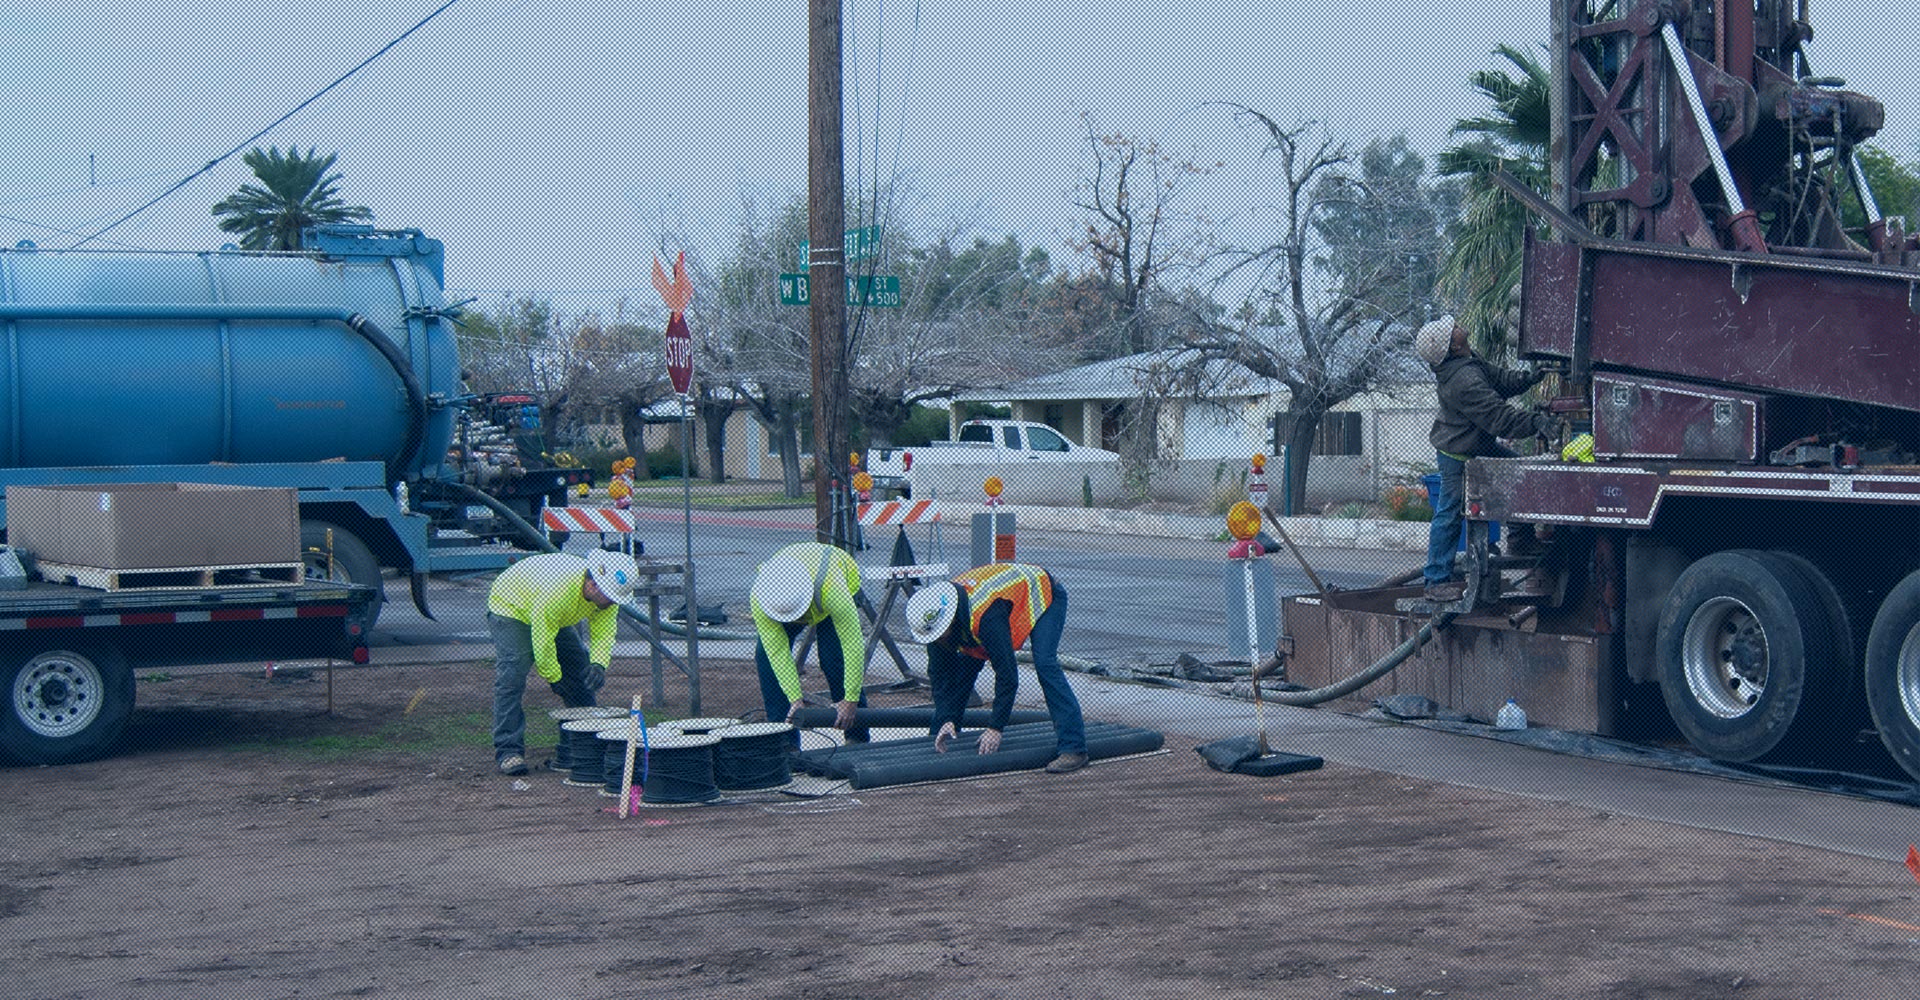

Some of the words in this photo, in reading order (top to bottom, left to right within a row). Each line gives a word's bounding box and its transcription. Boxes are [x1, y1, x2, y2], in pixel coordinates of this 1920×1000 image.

[781, 279, 793, 299] W
[874, 277, 888, 290] ST
[876, 291, 899, 305] 500
[667, 336, 691, 369] STOP
